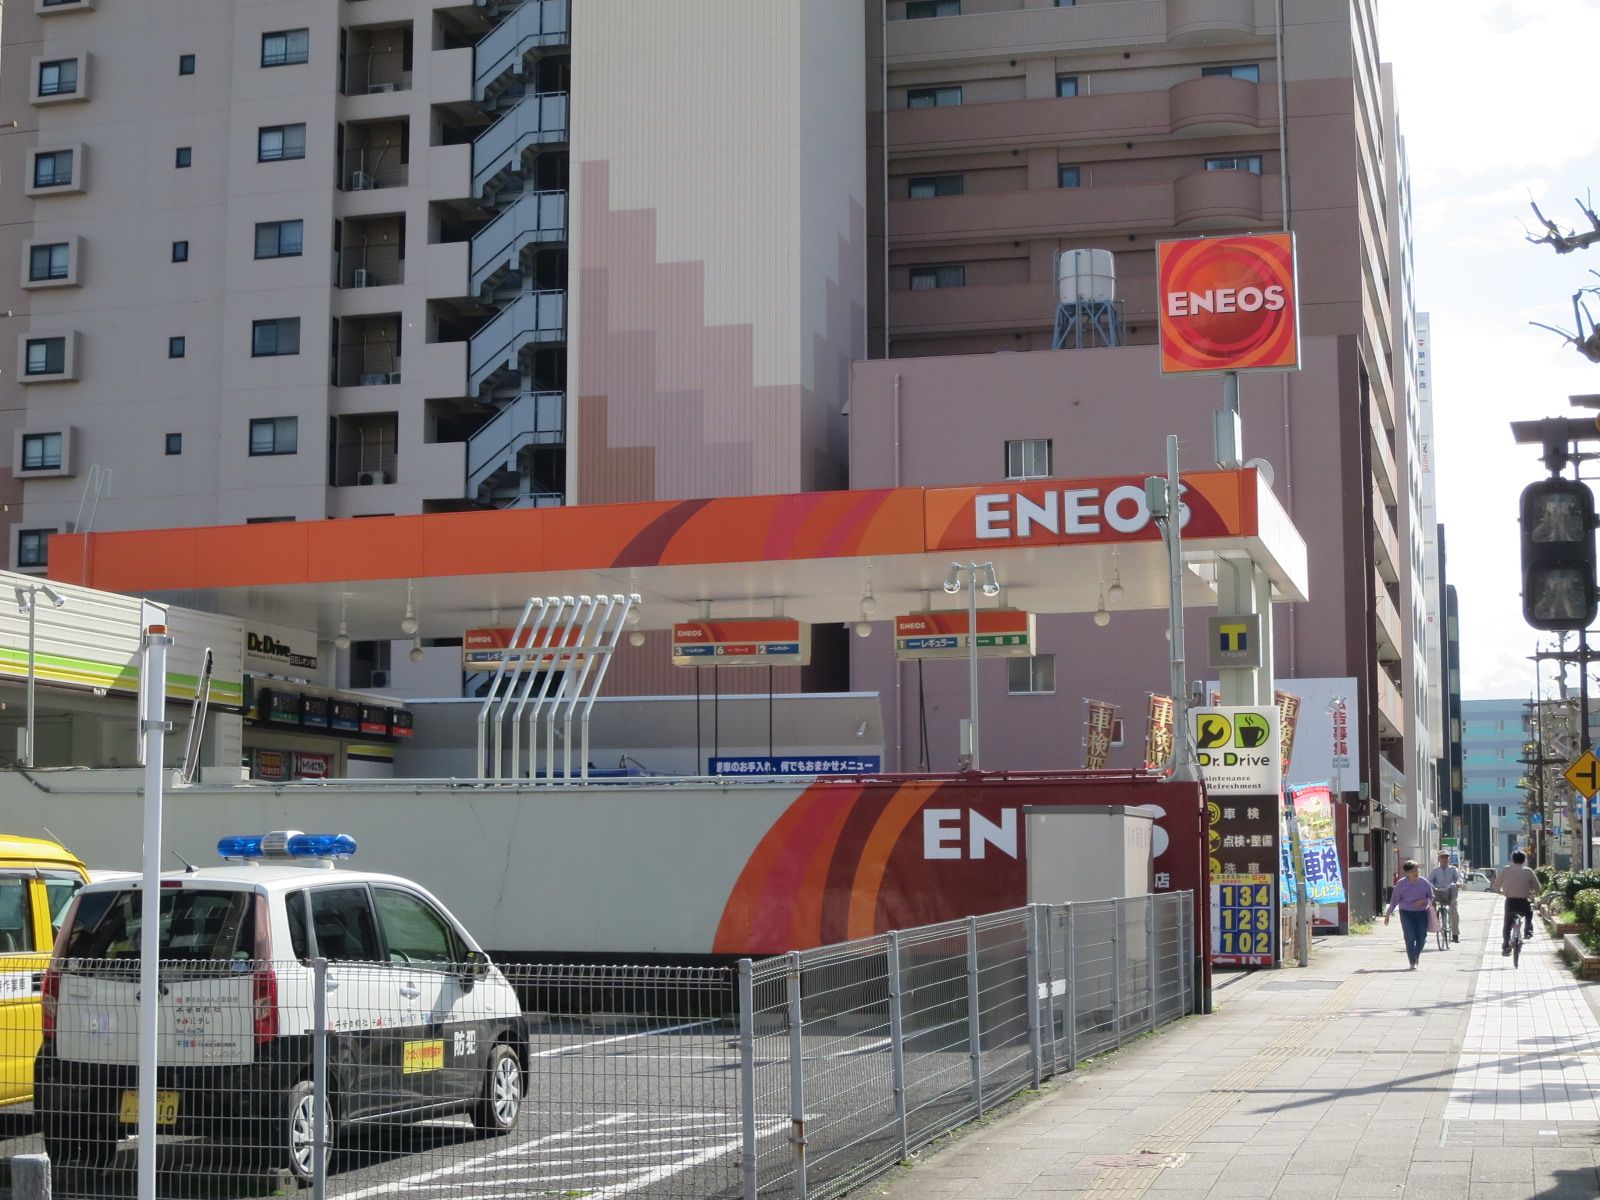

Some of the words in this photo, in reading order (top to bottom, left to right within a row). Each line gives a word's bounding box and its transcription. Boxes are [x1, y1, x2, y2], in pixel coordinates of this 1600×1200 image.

[1167, 285, 1285, 317] ENEOS
[468, 636, 492, 644] ENEOS
[675, 647, 682, 655] 3
[717, 646, 724, 655] 6
[760, 645, 767, 654] 2
[1197, 753, 1219, 767] Dr.
[1223, 753, 1270, 766] Drive
[1223, 807, 1260, 819] 車検
[1224, 863, 1260, 874] 洗車
[1222, 885, 1269, 906] 134
[1222, 909, 1269, 930] 123
[1223, 932, 1269, 953] 102
[1241, 956, 1262, 965] IN
[453, 1029, 476, 1057] 防犯
